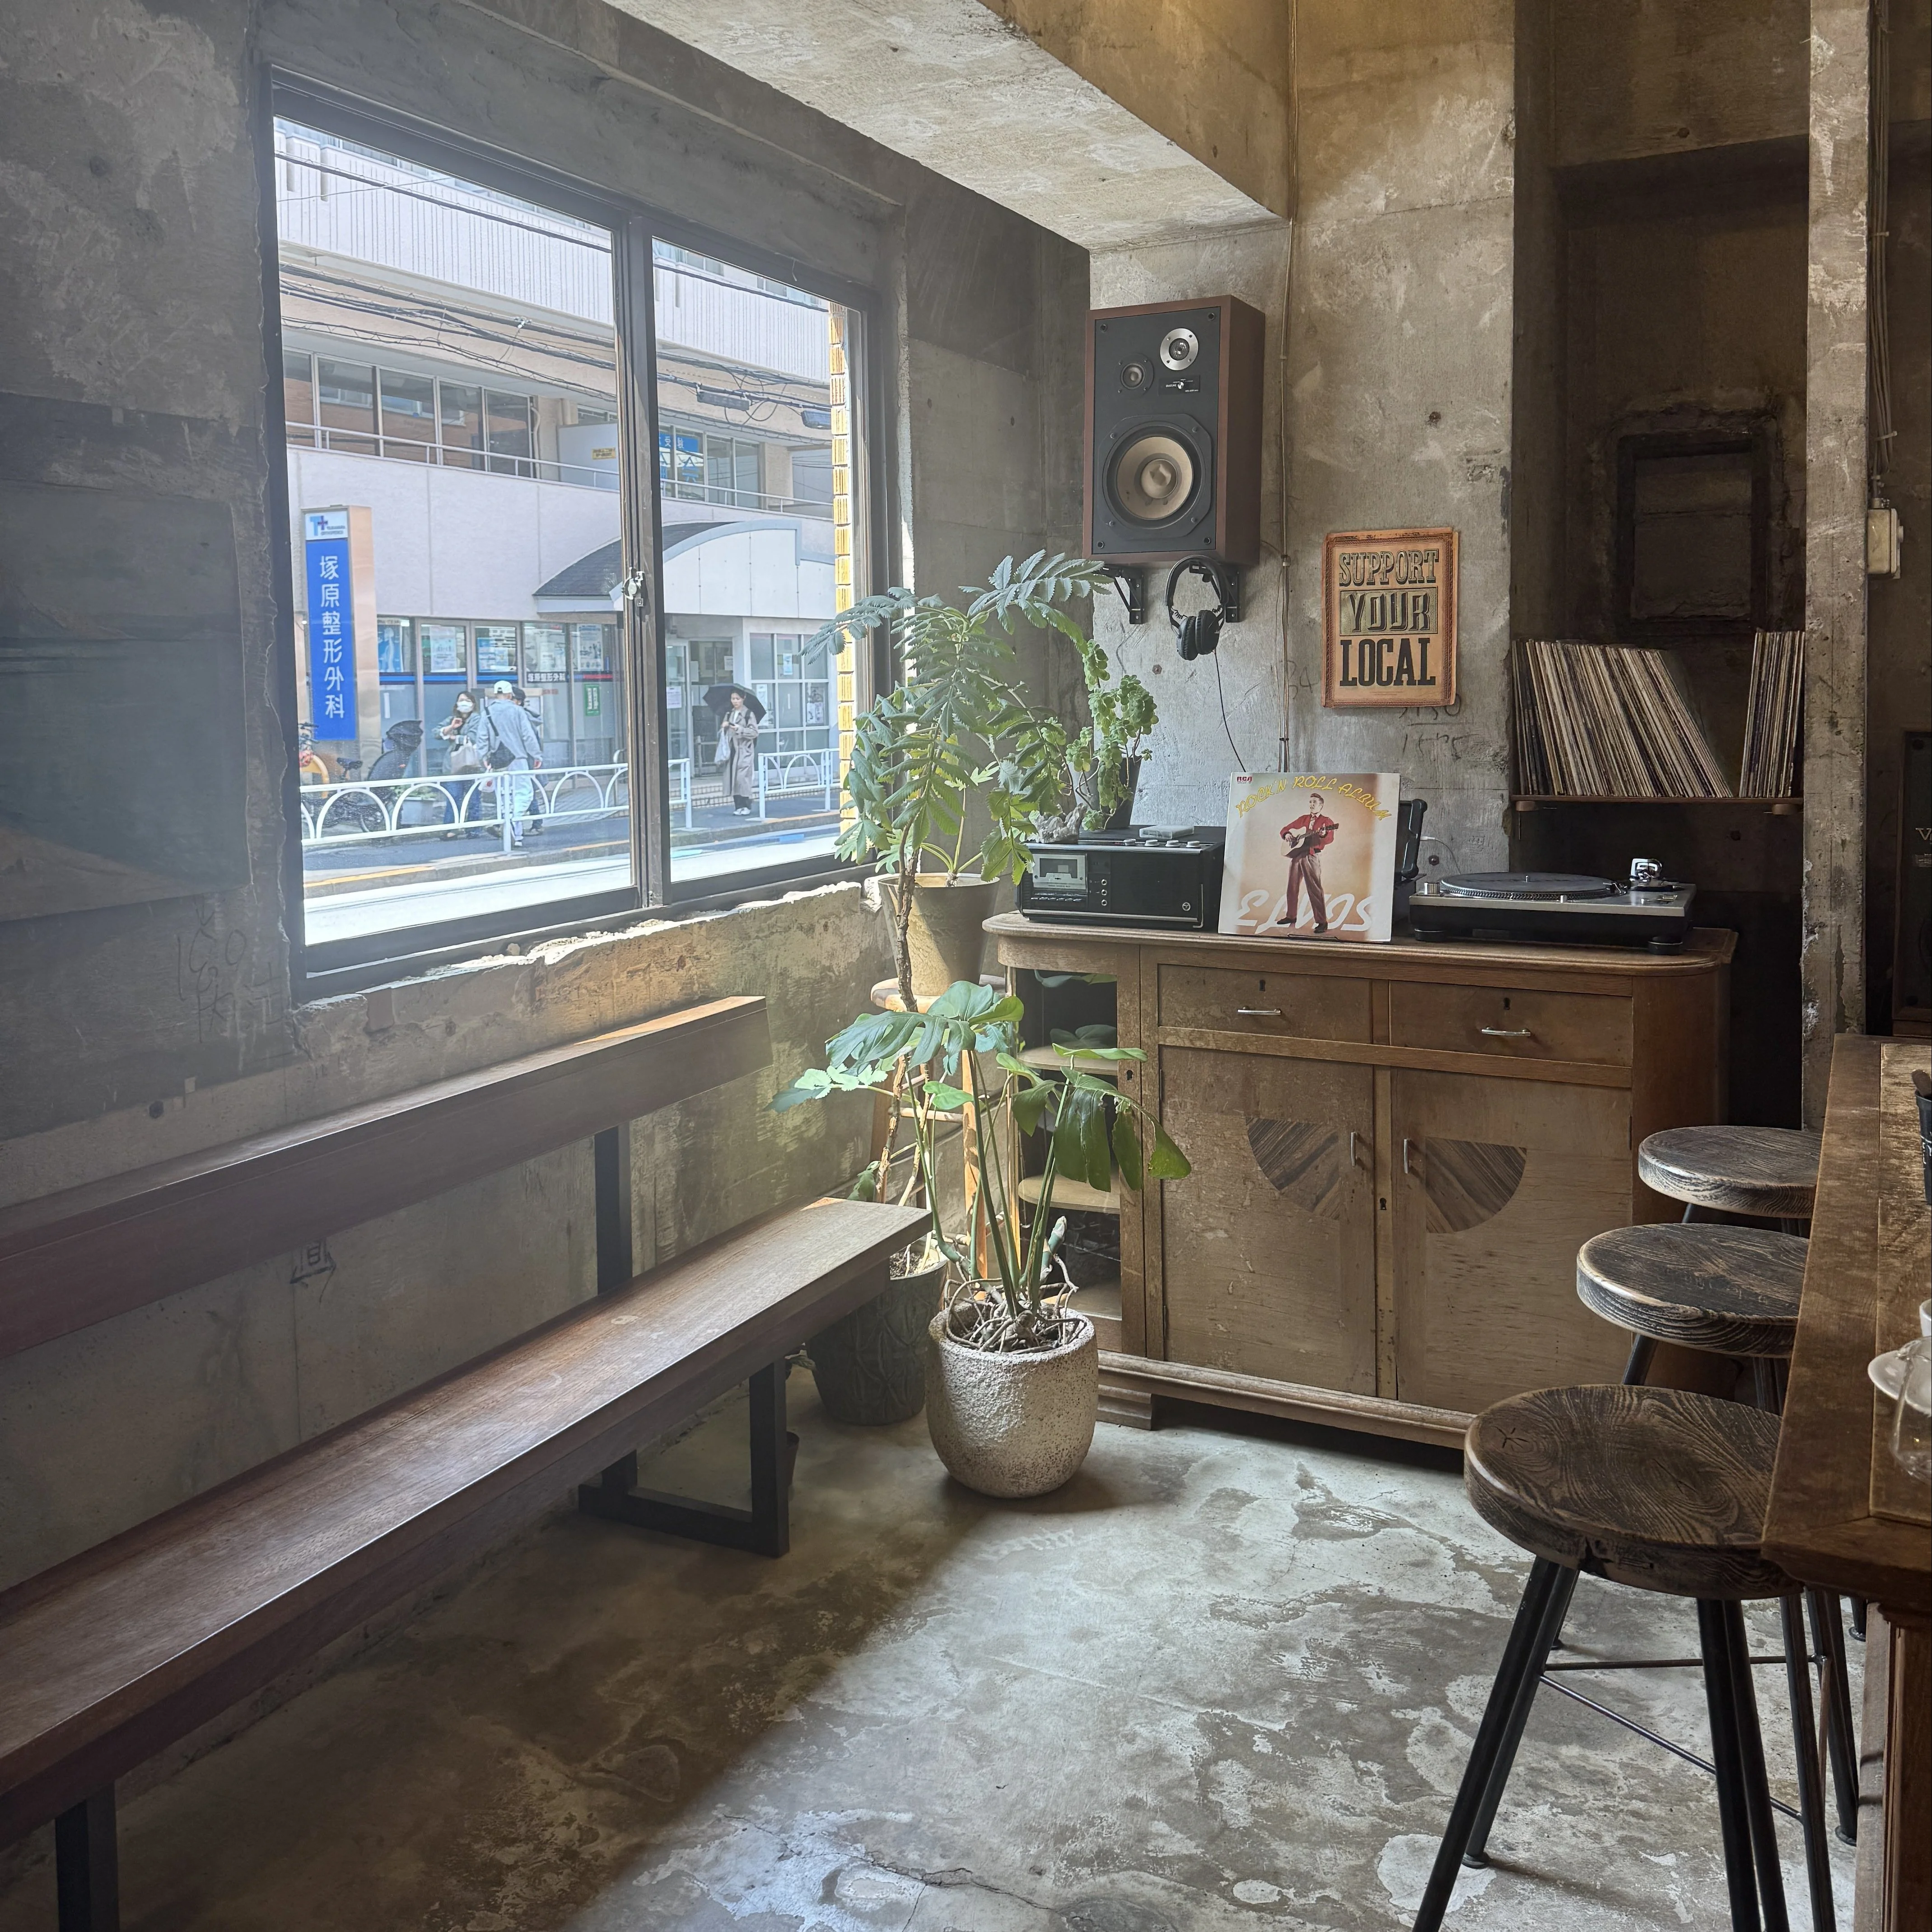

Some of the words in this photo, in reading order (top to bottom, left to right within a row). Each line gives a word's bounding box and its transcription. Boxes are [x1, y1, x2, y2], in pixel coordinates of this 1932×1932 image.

[1339, 549, 1439, 587] SUPPORT
[1348, 590, 1430, 632] YOUR
[319, 555, 345, 719] 塚原整形外科
[1339, 638, 1436, 687] LOCAL
[1292, 775, 1337, 790] ROLL
[1338, 783, 1392, 821] ALBUM
[1915, 828, 1932, 841] V
